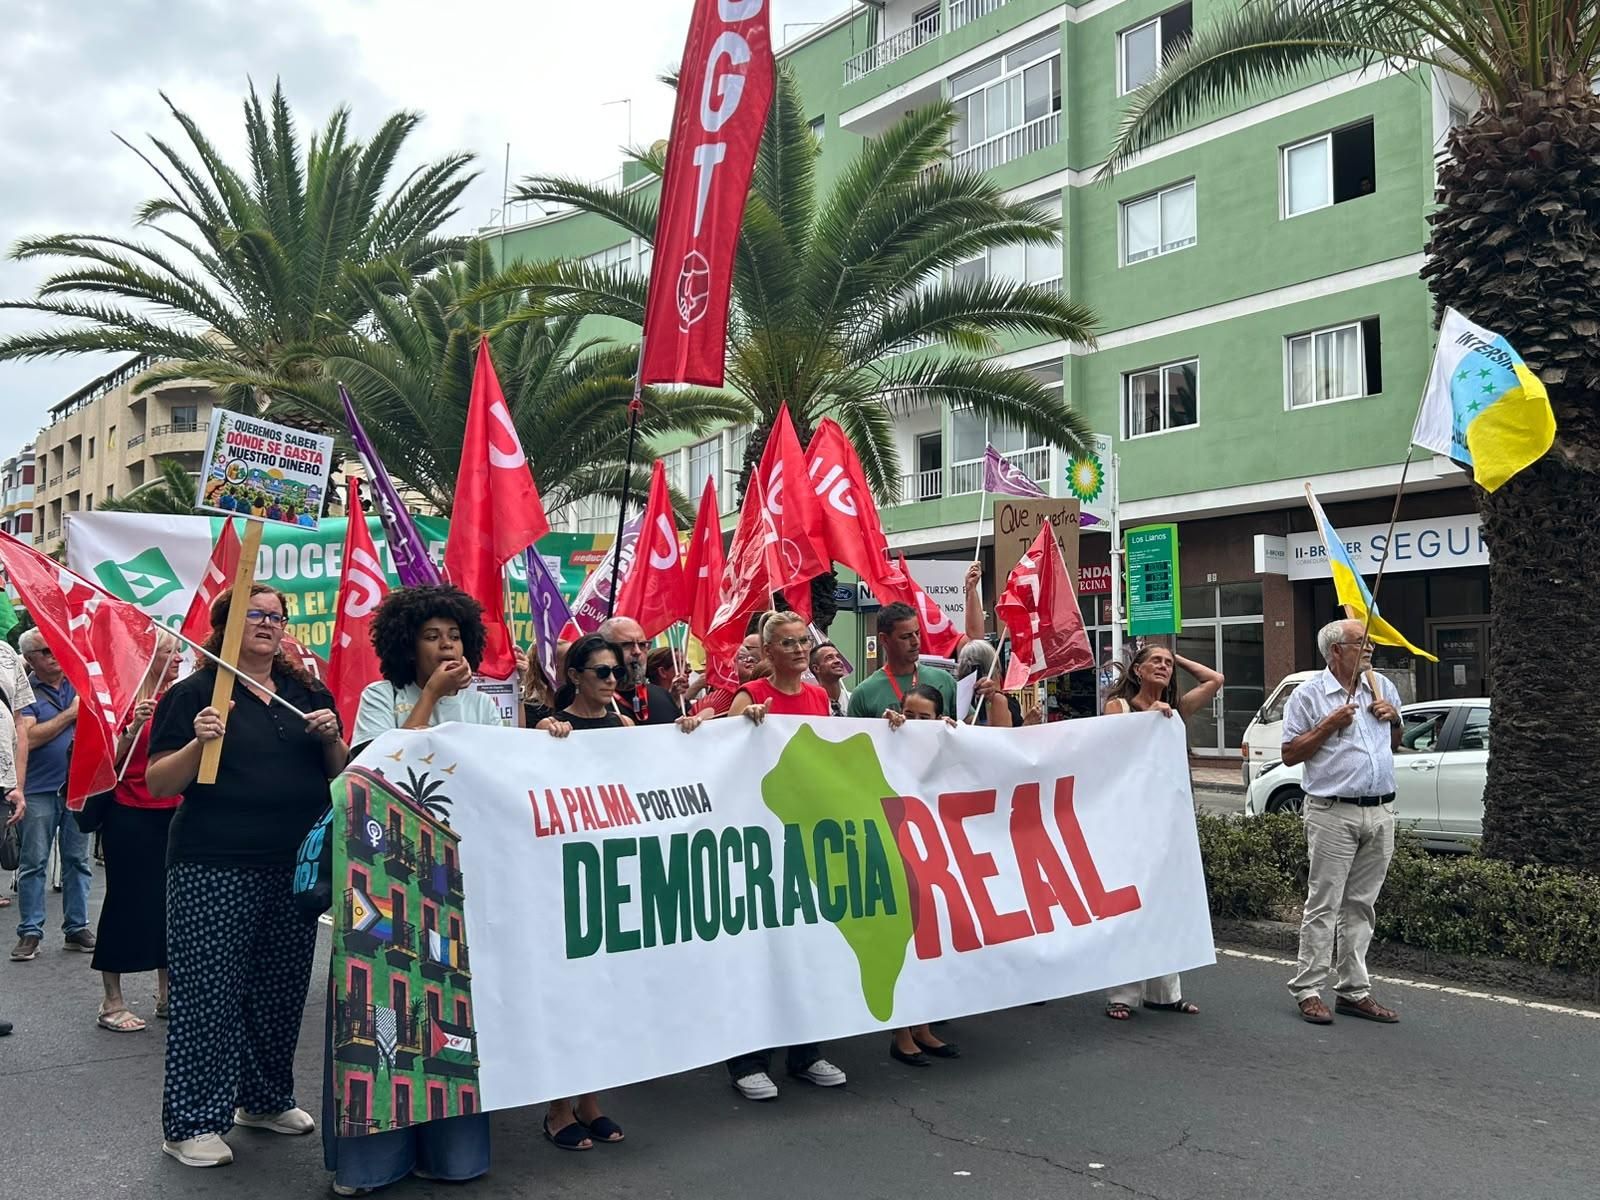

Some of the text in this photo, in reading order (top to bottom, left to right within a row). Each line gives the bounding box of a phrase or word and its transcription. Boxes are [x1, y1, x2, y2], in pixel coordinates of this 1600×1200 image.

[693, 0, 763, 238] GT
[234, 419, 318, 450] QUEREMOS SABER
[1096, 440, 1107, 451] bp
[228, 445, 323, 477] NUESTRO DINERO.
[266, 441, 282, 456] SE
[283, 445, 323, 464] GASTA
[1001, 504, 1029, 534] Que
[1145, 533, 1167, 542] Llanos
[1295, 541, 1362, 559] II-BRER
[925, 585, 959, 594] TURISMO
[304, 591, 328, 616] EL
[944, 603, 964, 612] NAOS
[528, 782, 713, 838] LA PALMA POR UNA
[879, 775, 1142, 960] REAL
